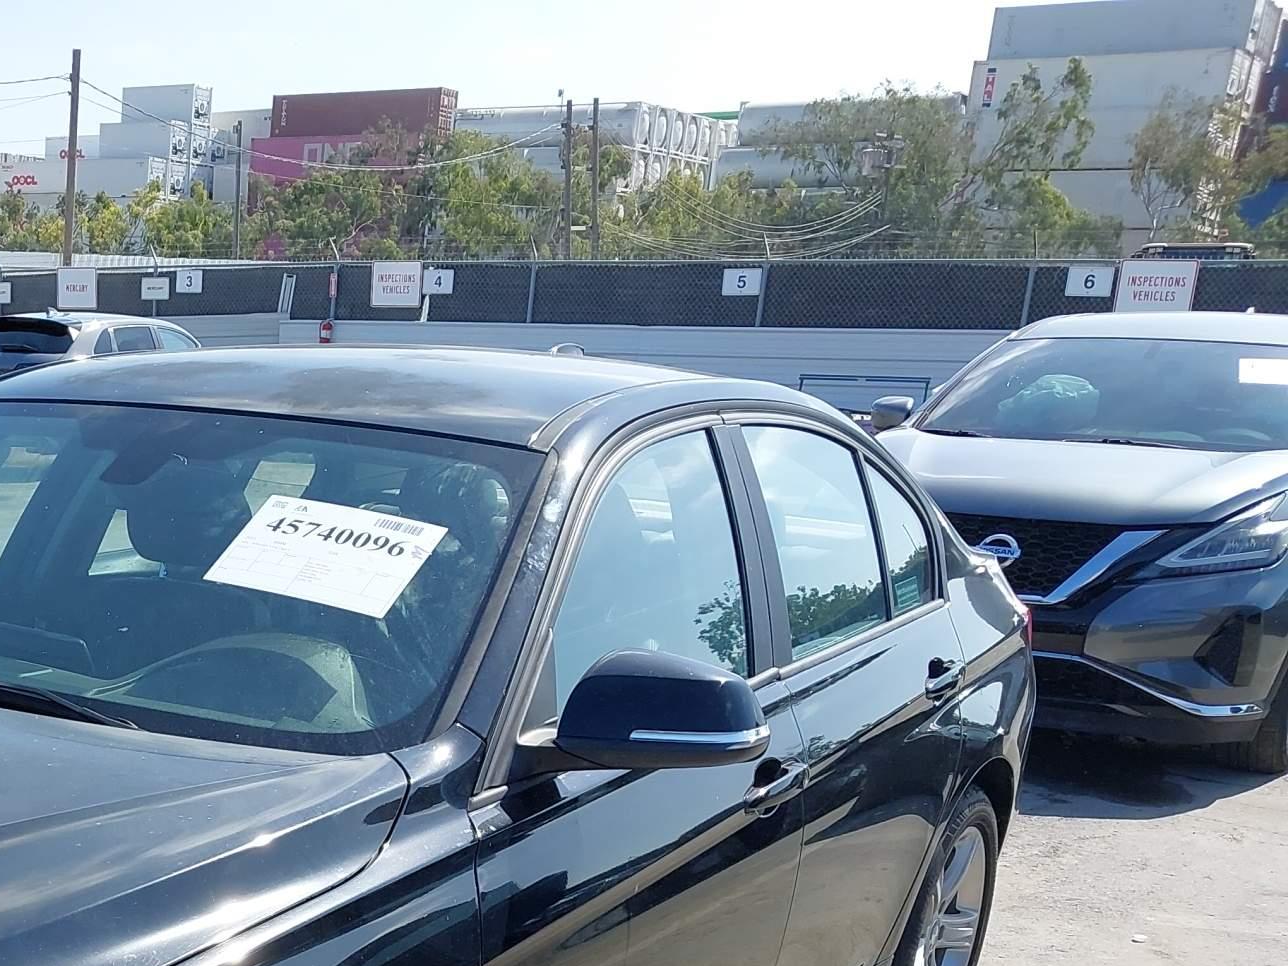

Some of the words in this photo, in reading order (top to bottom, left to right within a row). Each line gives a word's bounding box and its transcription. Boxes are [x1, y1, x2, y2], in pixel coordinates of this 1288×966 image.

[11, 175, 38, 186] OOCL
[185, 275, 193, 288] 3
[377, 273, 416, 283] INSPECTIONS
[434, 276, 442, 288] 4
[737, 275, 747, 289] 5
[1083, 274, 1096, 289] 6
[1127, 275, 1187, 288] INSPECTIONS
[65, 284, 89, 293] MERCURY
[382, 285, 410, 295] VEHICLES
[1132, 290, 1177, 302] VEHICLES
[266, 516, 411, 557] 45740096
